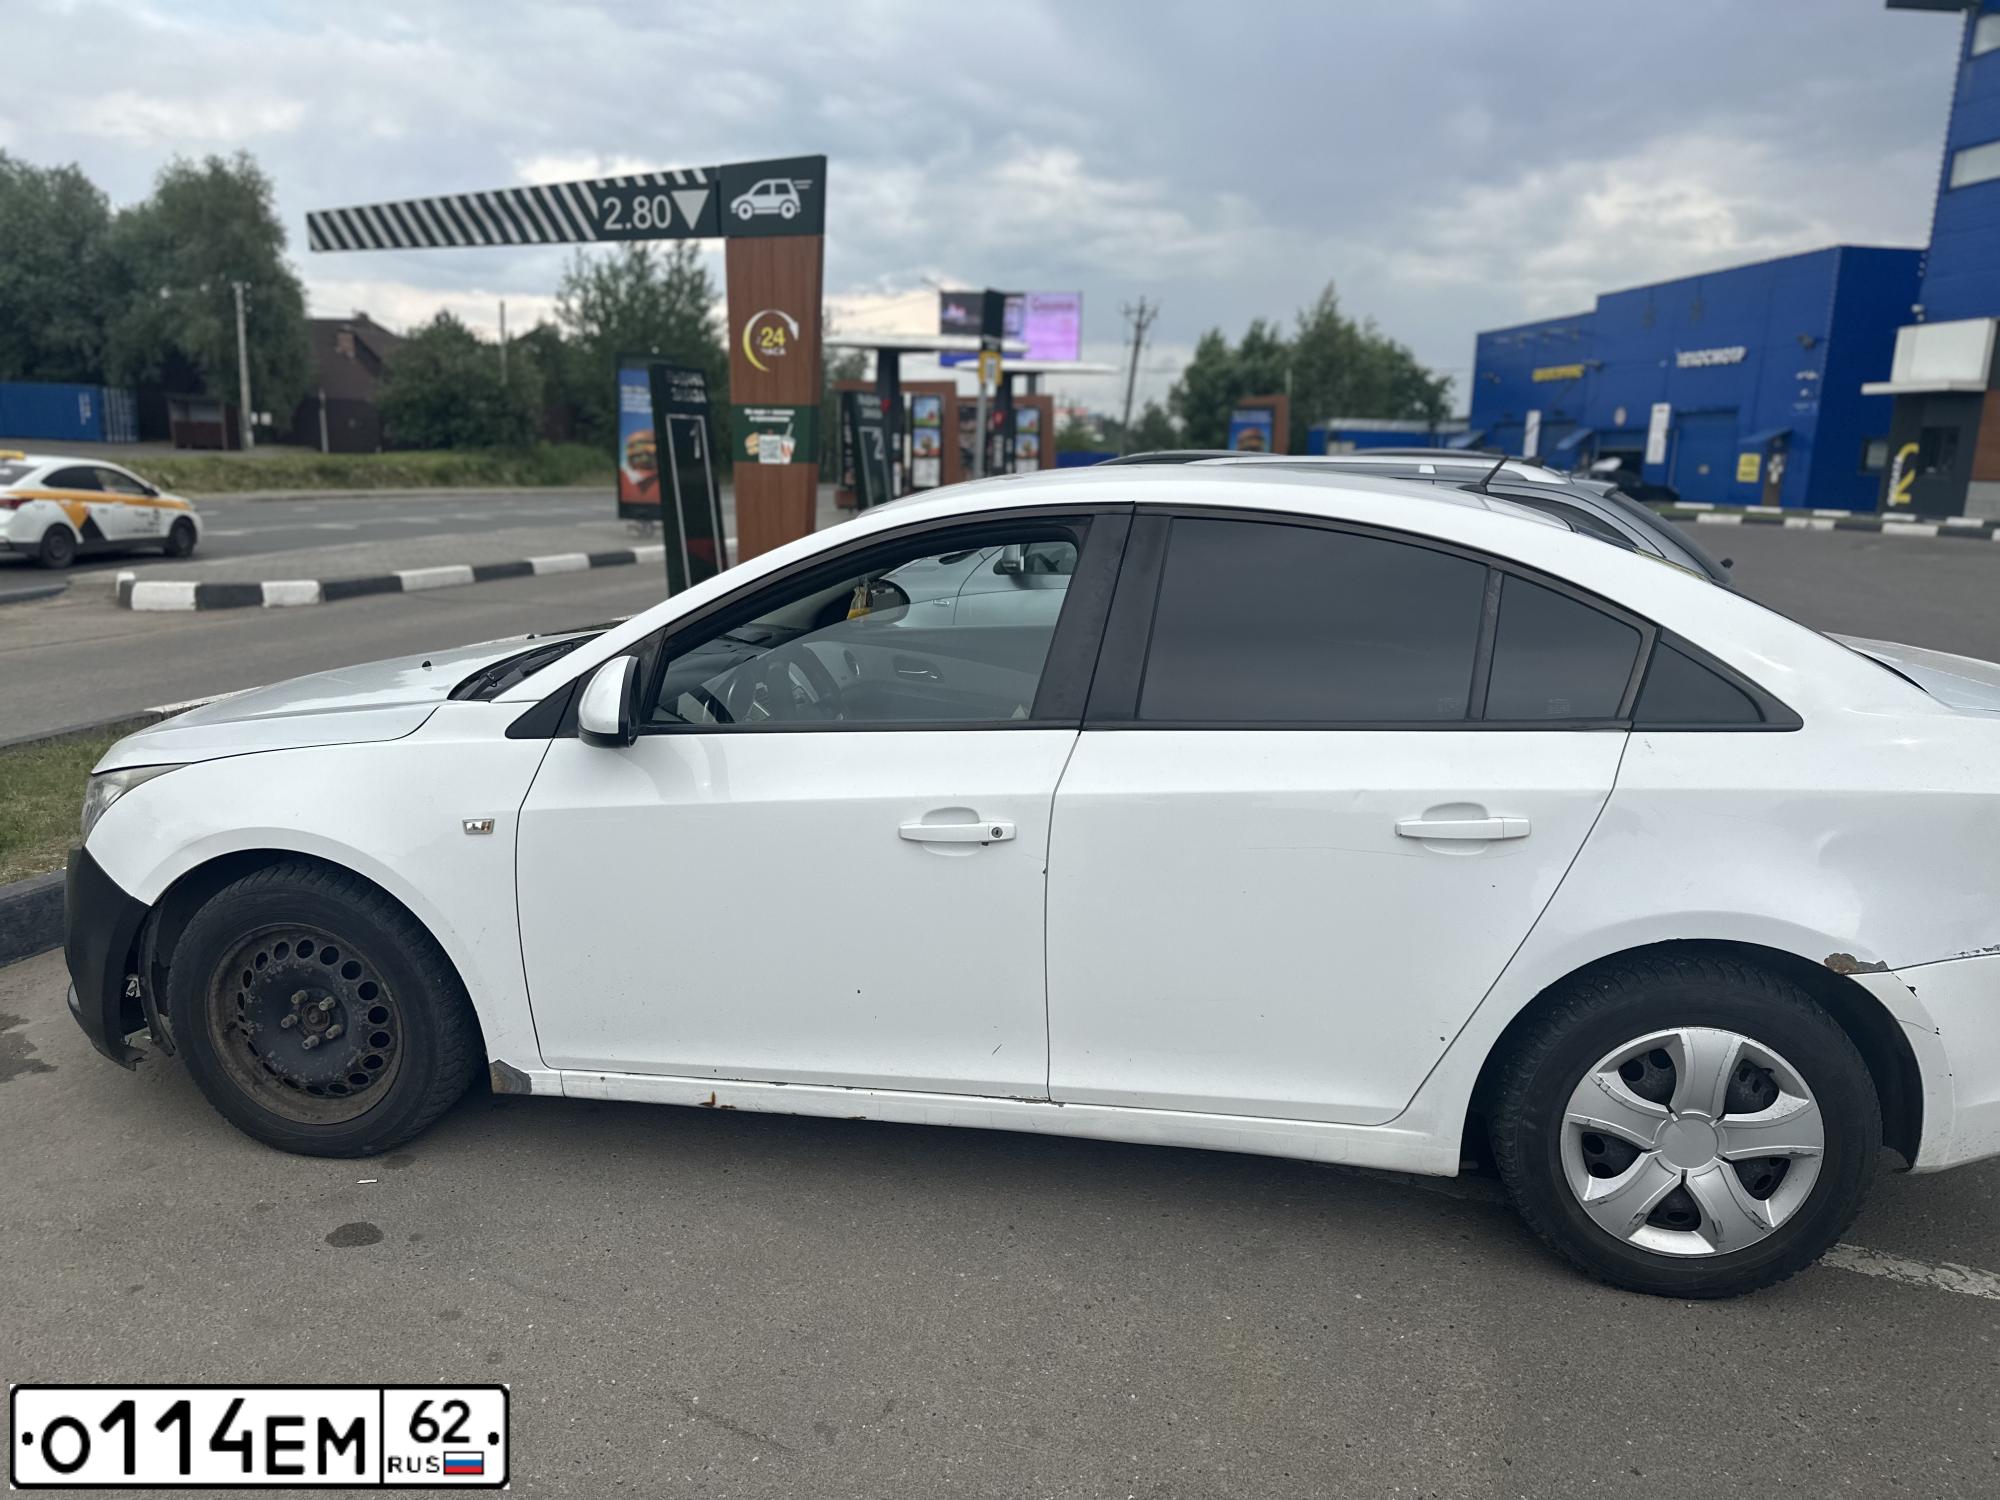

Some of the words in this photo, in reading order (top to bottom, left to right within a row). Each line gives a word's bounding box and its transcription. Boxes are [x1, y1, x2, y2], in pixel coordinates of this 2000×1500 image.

[603, 195, 672, 230] 2.80
[761, 326, 785, 348] 24
[689, 421, 702, 459] 1
[1892, 442, 1920, 503] 2
